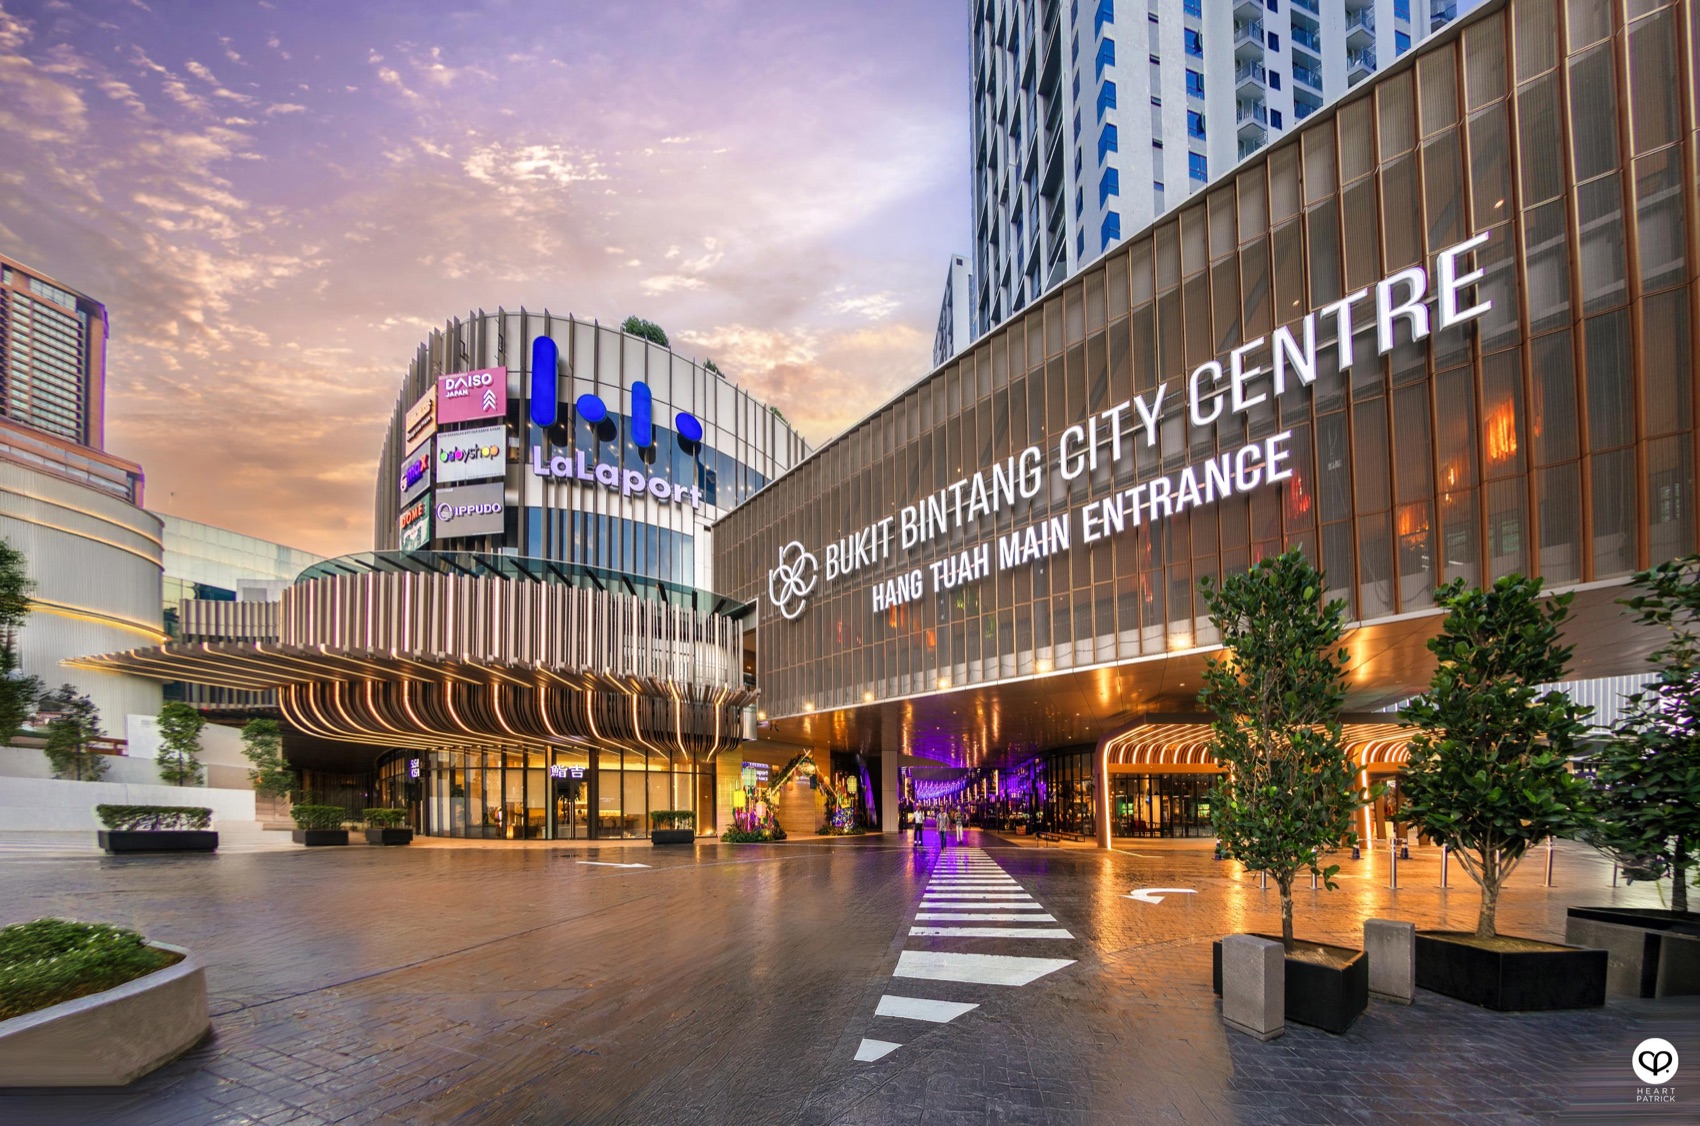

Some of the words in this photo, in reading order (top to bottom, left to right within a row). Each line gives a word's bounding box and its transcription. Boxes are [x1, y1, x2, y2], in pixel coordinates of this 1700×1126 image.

[446, 373, 492, 390] DAISO
[446, 389, 468, 398] JAPAN
[825, 516, 895, 581] BUKIT
[900, 445, 1042, 550] BINTANG
[1059, 383, 1168, 480] CITY
[1189, 231, 1493, 428] CENTRE
[440, 443, 499, 464] babyshop
[533, 445, 702, 510] LaLaport
[400, 503, 424, 529] DOME
[454, 503, 501, 516] IPPUDO
[872, 570, 923, 613] HANG
[932, 543, 989, 592] TUAH
[999, 513, 1069, 568] MAIN
[1082, 429, 1293, 544] ENTRANCE
